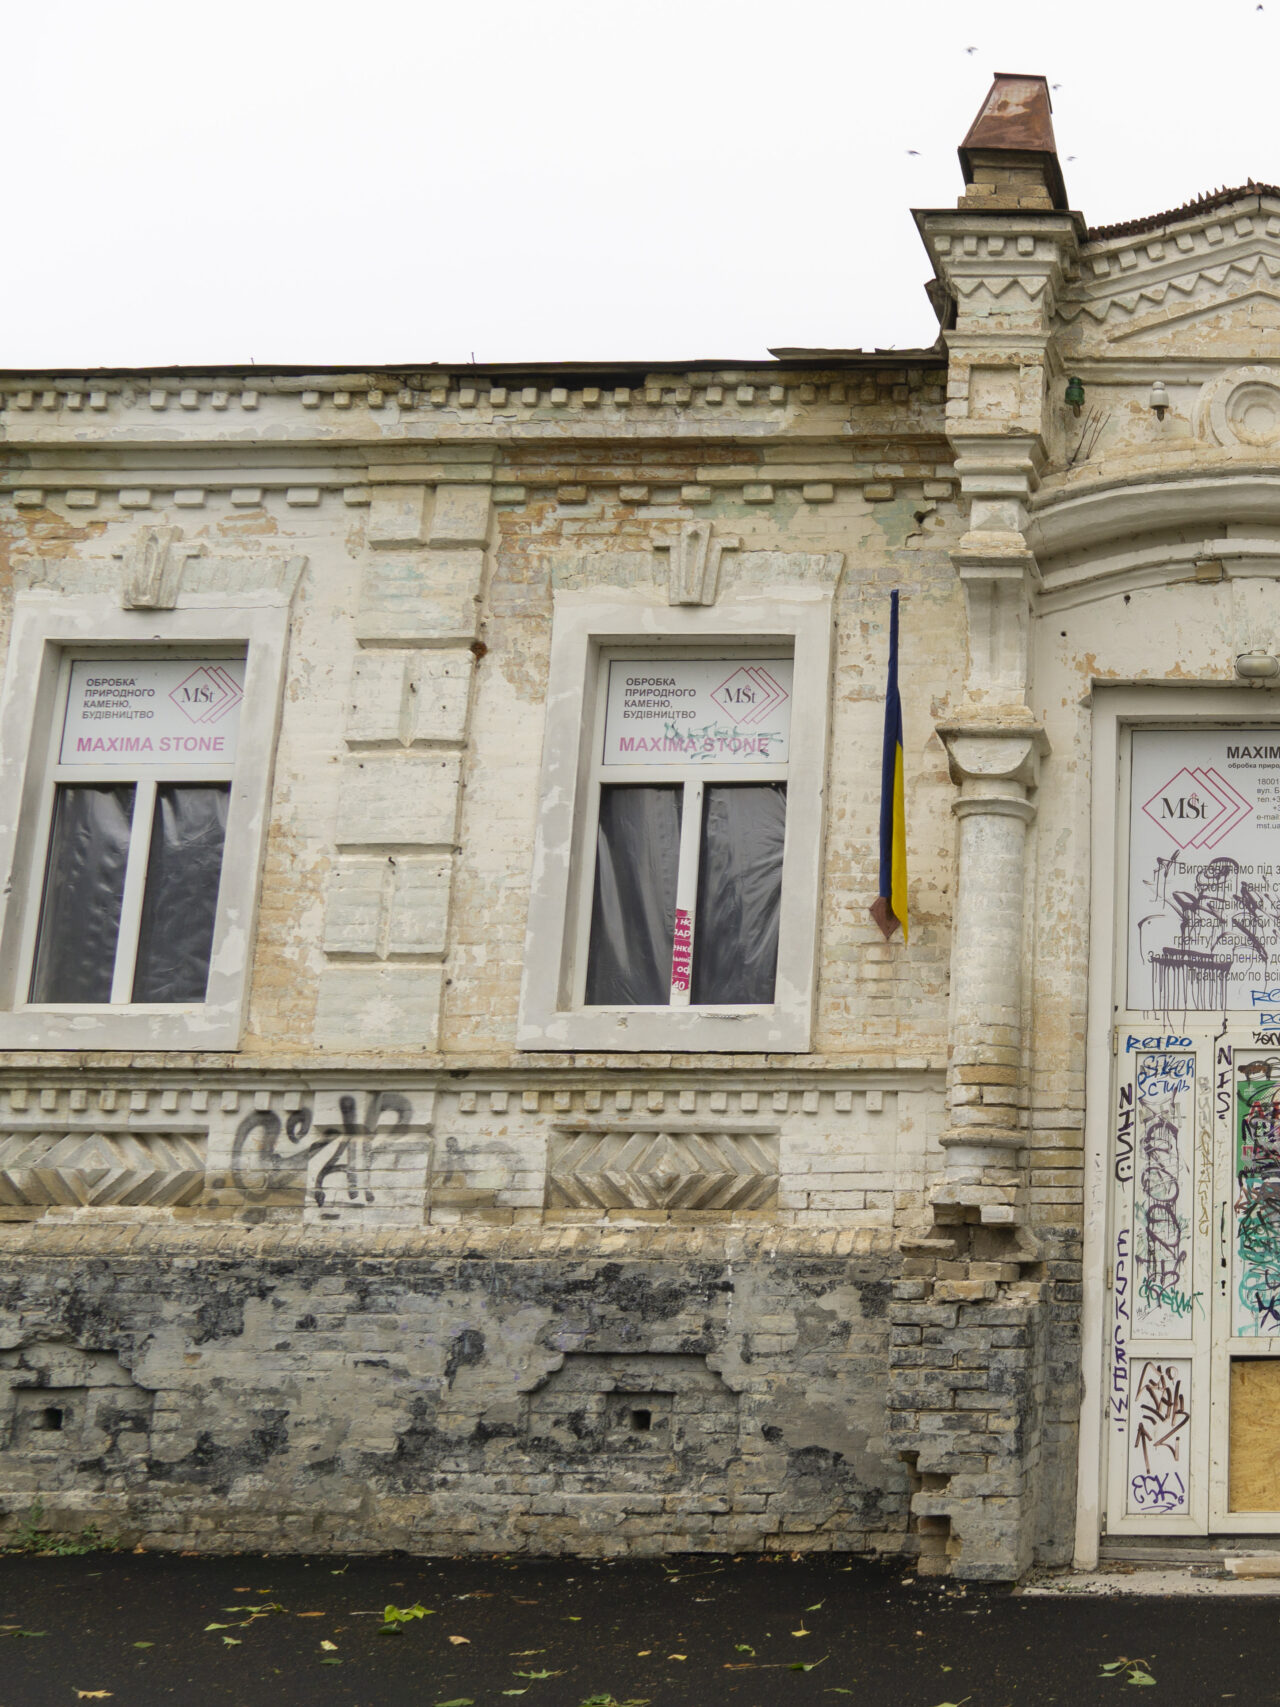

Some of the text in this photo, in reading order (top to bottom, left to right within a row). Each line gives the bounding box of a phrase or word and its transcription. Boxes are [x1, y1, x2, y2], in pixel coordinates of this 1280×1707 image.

[86, 678, 136, 687] ОБРОБКА
[626, 678, 676, 687] ОБРОБКА
[85, 689, 155, 698] ПРИРОДНОГО
[625, 689, 696, 698] ПРИРОДНОГО
[83, 700, 132, 709] КАМЕНЮ,
[624, 700, 673, 709] КАМЕНЮ,
[82, 711, 154, 720] БУДІВНИЦТВО
[623, 710, 696, 720] БУДІВНИЦТВО
[76, 736, 225, 752] MAXIMA STONE
[619, 737, 769, 752] MAXIMA STONE
[1160, 797, 1208, 819] MSt
[1257, 862, 1273, 875] під
[1242, 880, 1269, 892] анні
[1249, 972, 1261, 981] по
